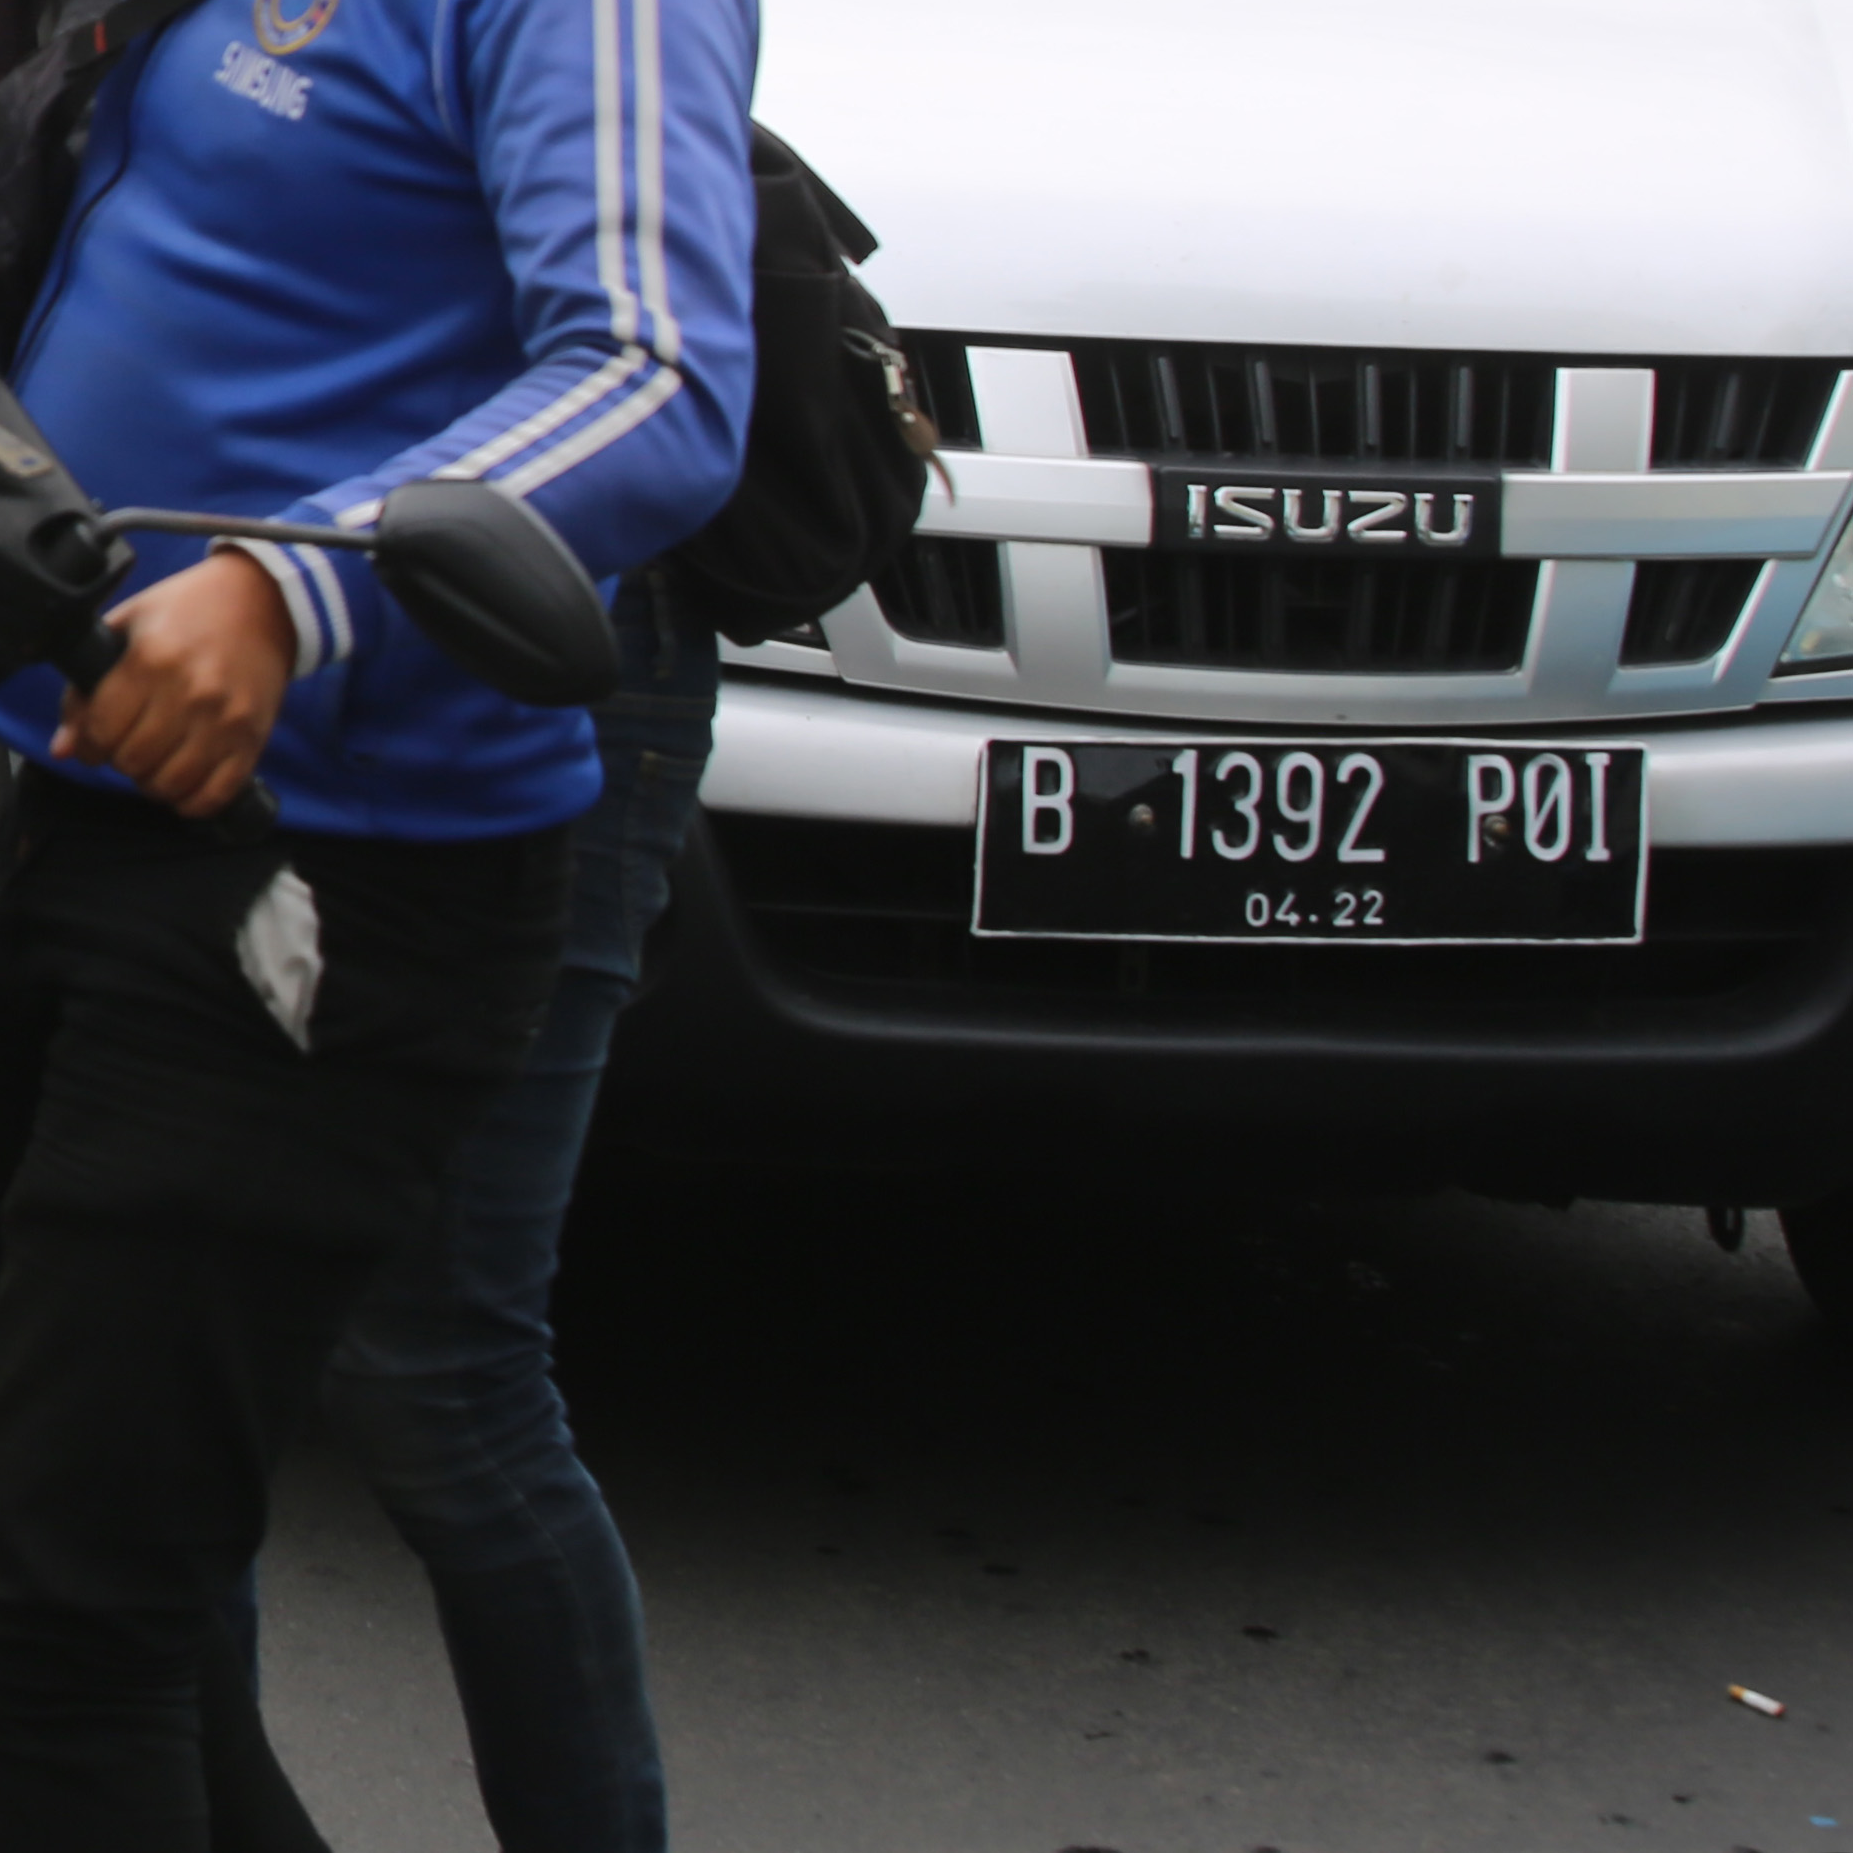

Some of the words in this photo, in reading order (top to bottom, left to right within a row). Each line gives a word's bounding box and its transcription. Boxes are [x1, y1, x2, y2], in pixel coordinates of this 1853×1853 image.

[214, 40, 313, 121] SAMSUNG
[1187, 484, 1474, 545] ISUZU
[1022, 746, 1077, 855] B
[1171, 748, 1386, 864] 1392
